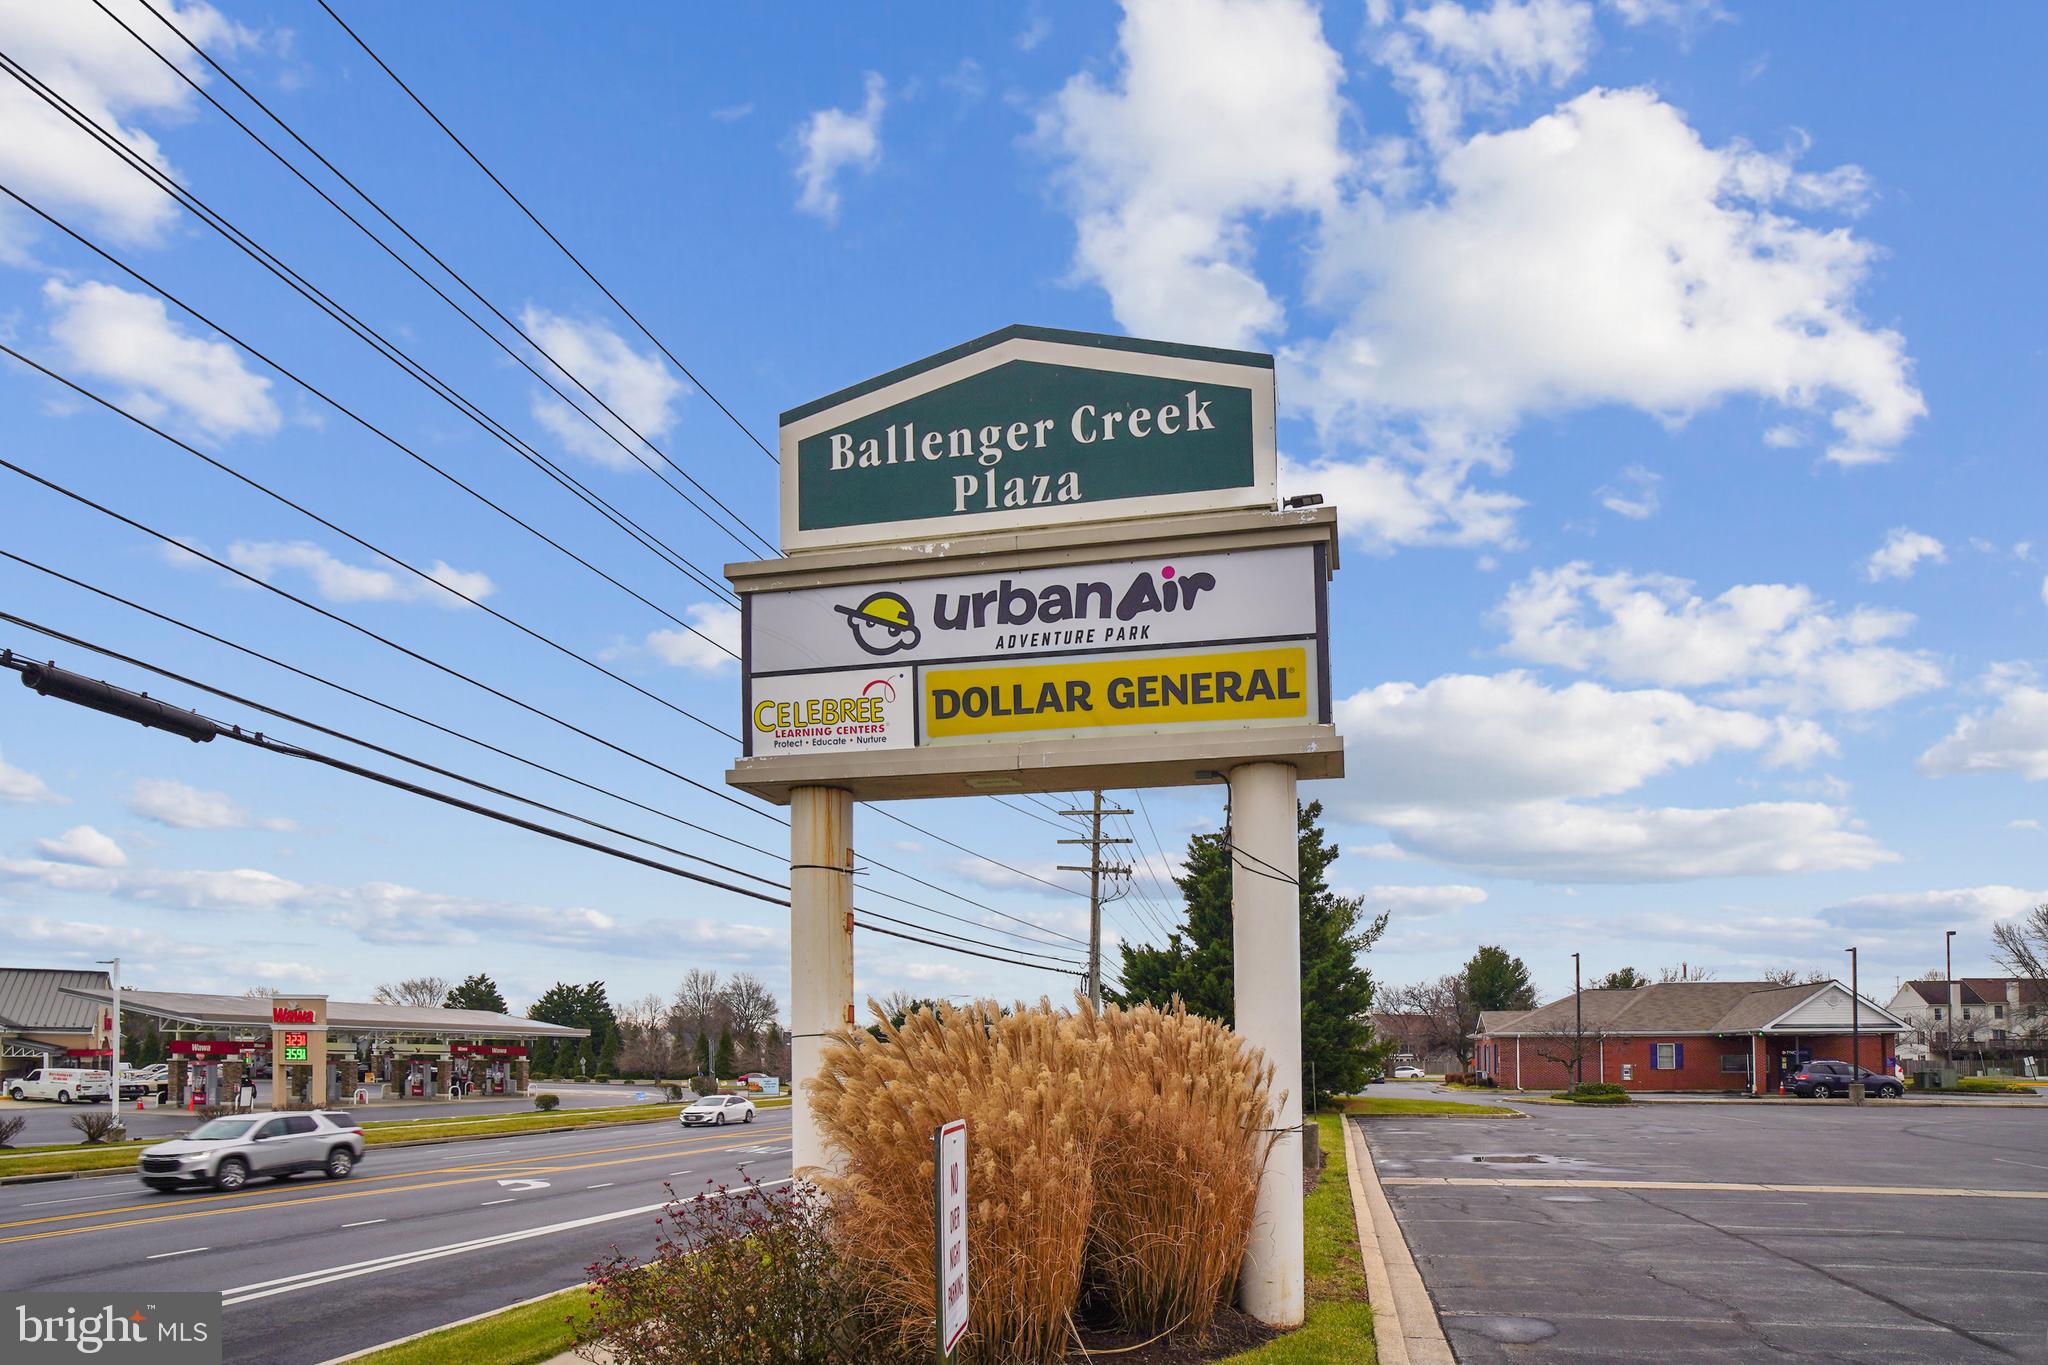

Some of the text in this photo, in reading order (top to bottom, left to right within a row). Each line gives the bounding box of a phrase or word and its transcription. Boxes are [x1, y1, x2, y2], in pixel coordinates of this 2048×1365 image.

[829, 389, 1216, 471] Ballenger Creek
[952, 470, 1083, 512] Plaza
[995, 624, 1151, 650] ADVENTURE PARK
[932, 667, 1300, 719] DOLLAR GENERAL
[753, 697, 885, 732] CELEBREE
[774, 735, 887, 748] Protect Educate Nurture
[775, 724, 885, 738] LEARNING CENTERS
[273, 1007, 315, 1023] Wawa
[192, 1043, 211, 1052] Wawa
[950, 1162, 959, 1197] NO
[950, 1205, 960, 1234] OVER
[948, 1273, 964, 1311] PARKING
